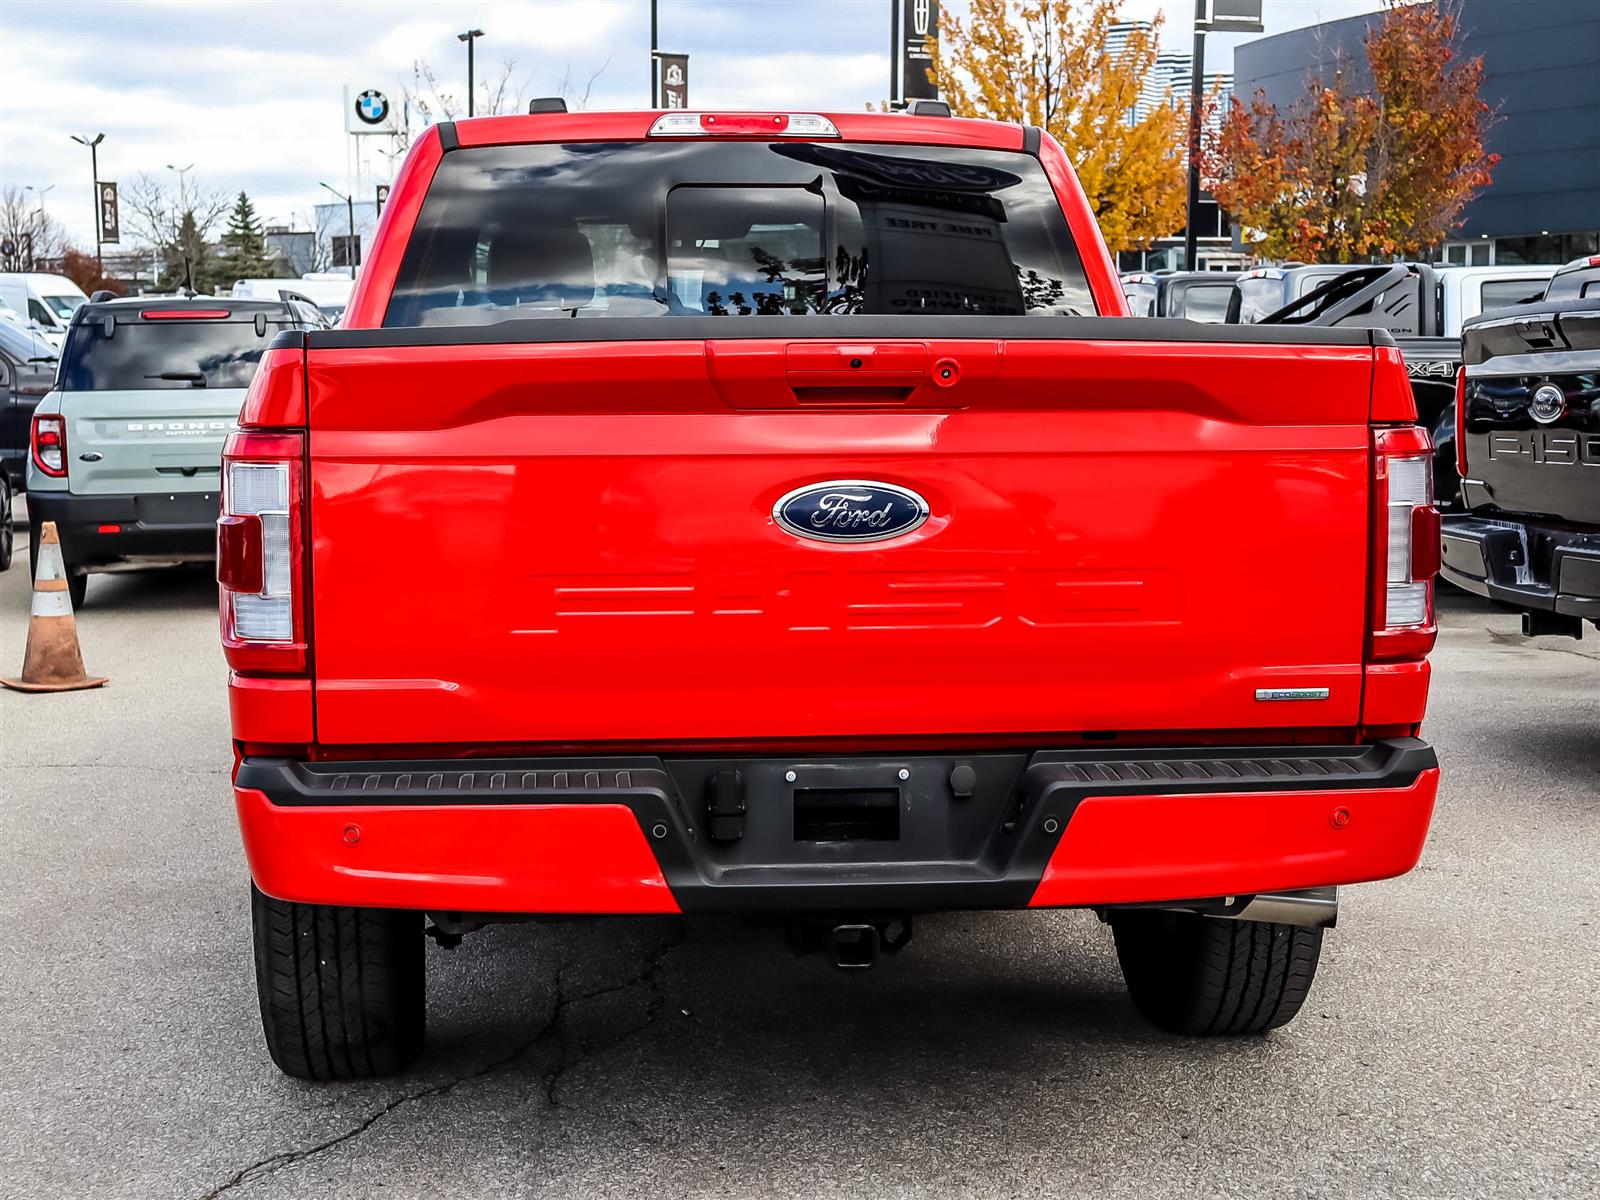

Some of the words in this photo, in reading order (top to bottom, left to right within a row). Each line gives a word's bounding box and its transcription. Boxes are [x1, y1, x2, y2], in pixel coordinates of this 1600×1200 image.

[810, 493, 893, 528] Ford
[508, 567, 1184, 634] F-150
[1272, 690, 1323, 698] ECOBOOST
